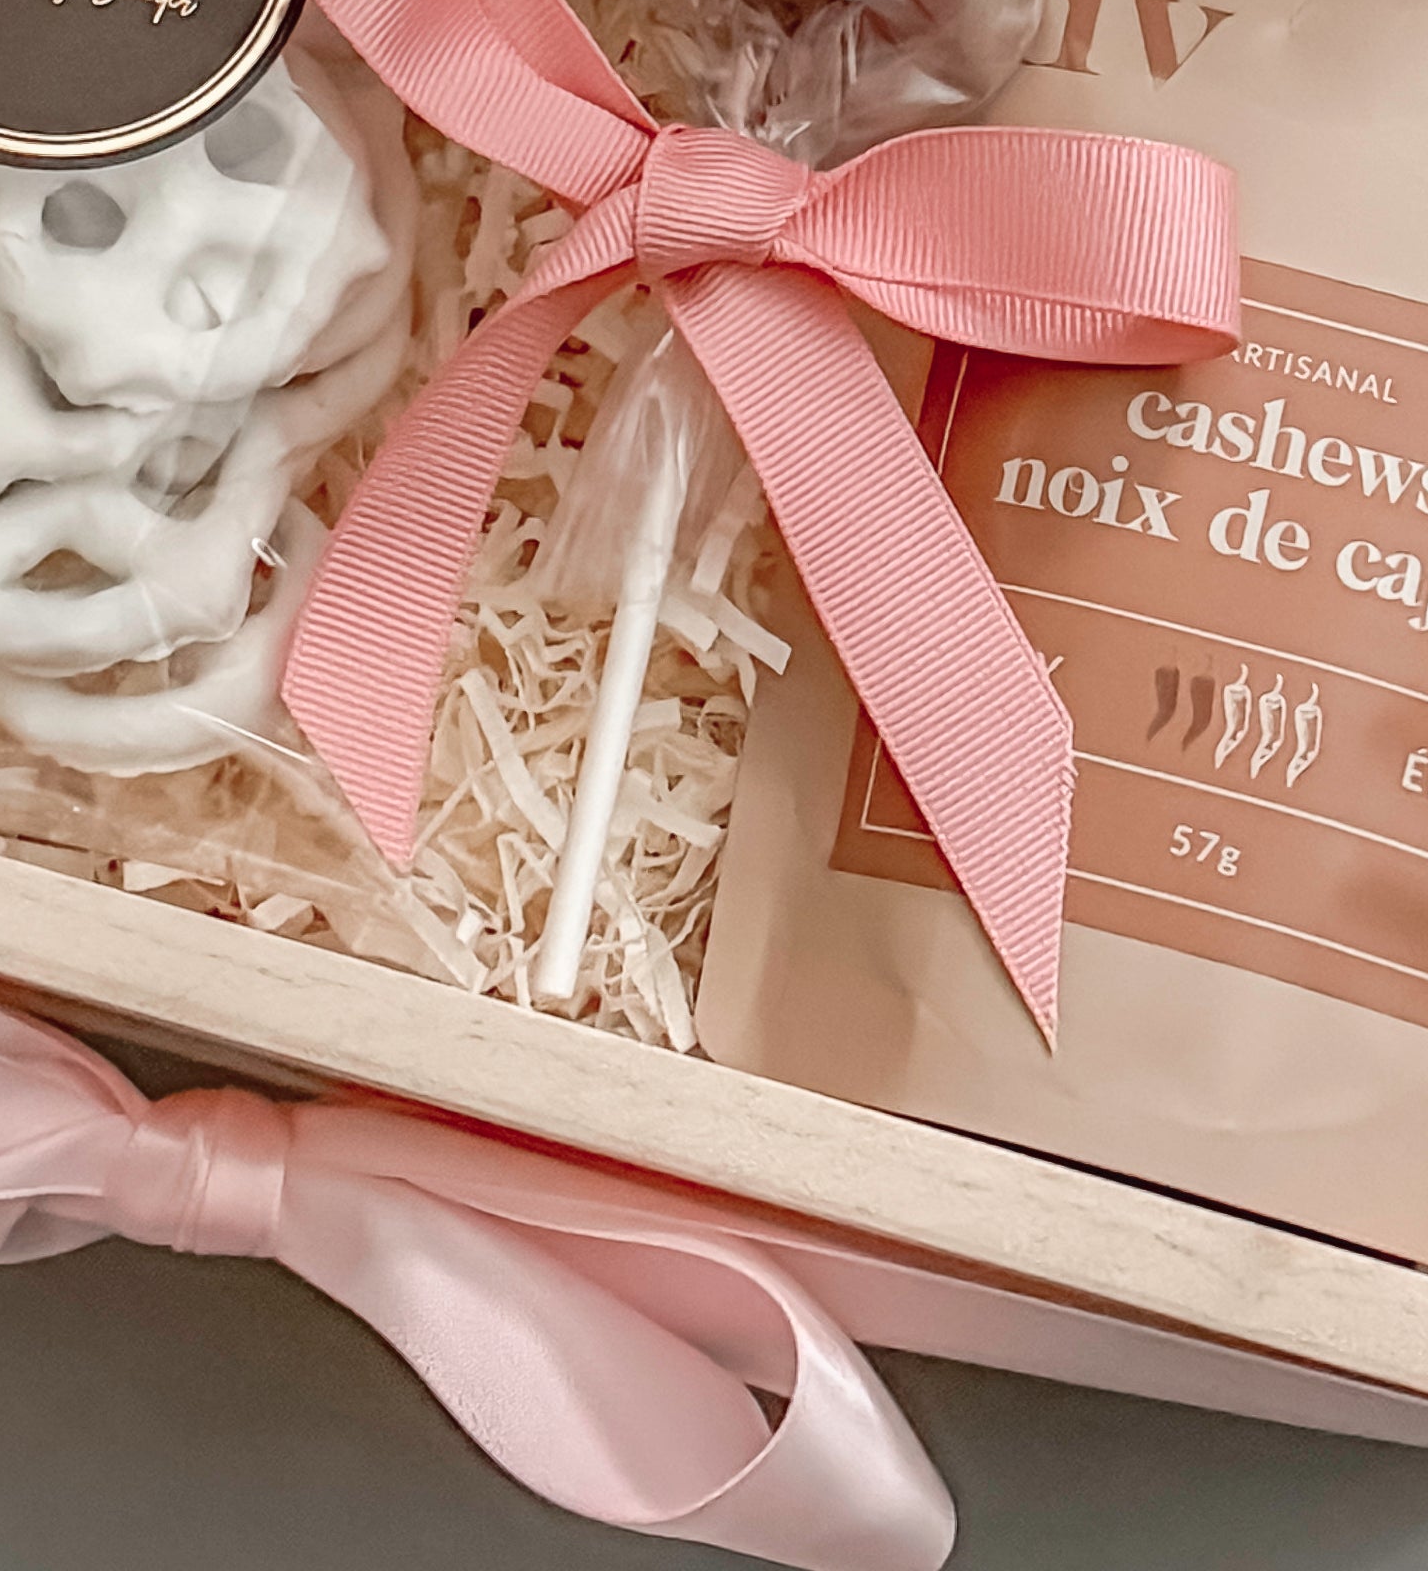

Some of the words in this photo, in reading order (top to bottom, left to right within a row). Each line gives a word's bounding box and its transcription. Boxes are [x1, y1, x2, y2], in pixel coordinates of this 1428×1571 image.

[993, 454, 1182, 543] noix
[1207, 487, 1312, 572] de
[1169, 823, 1243, 878] 57g
